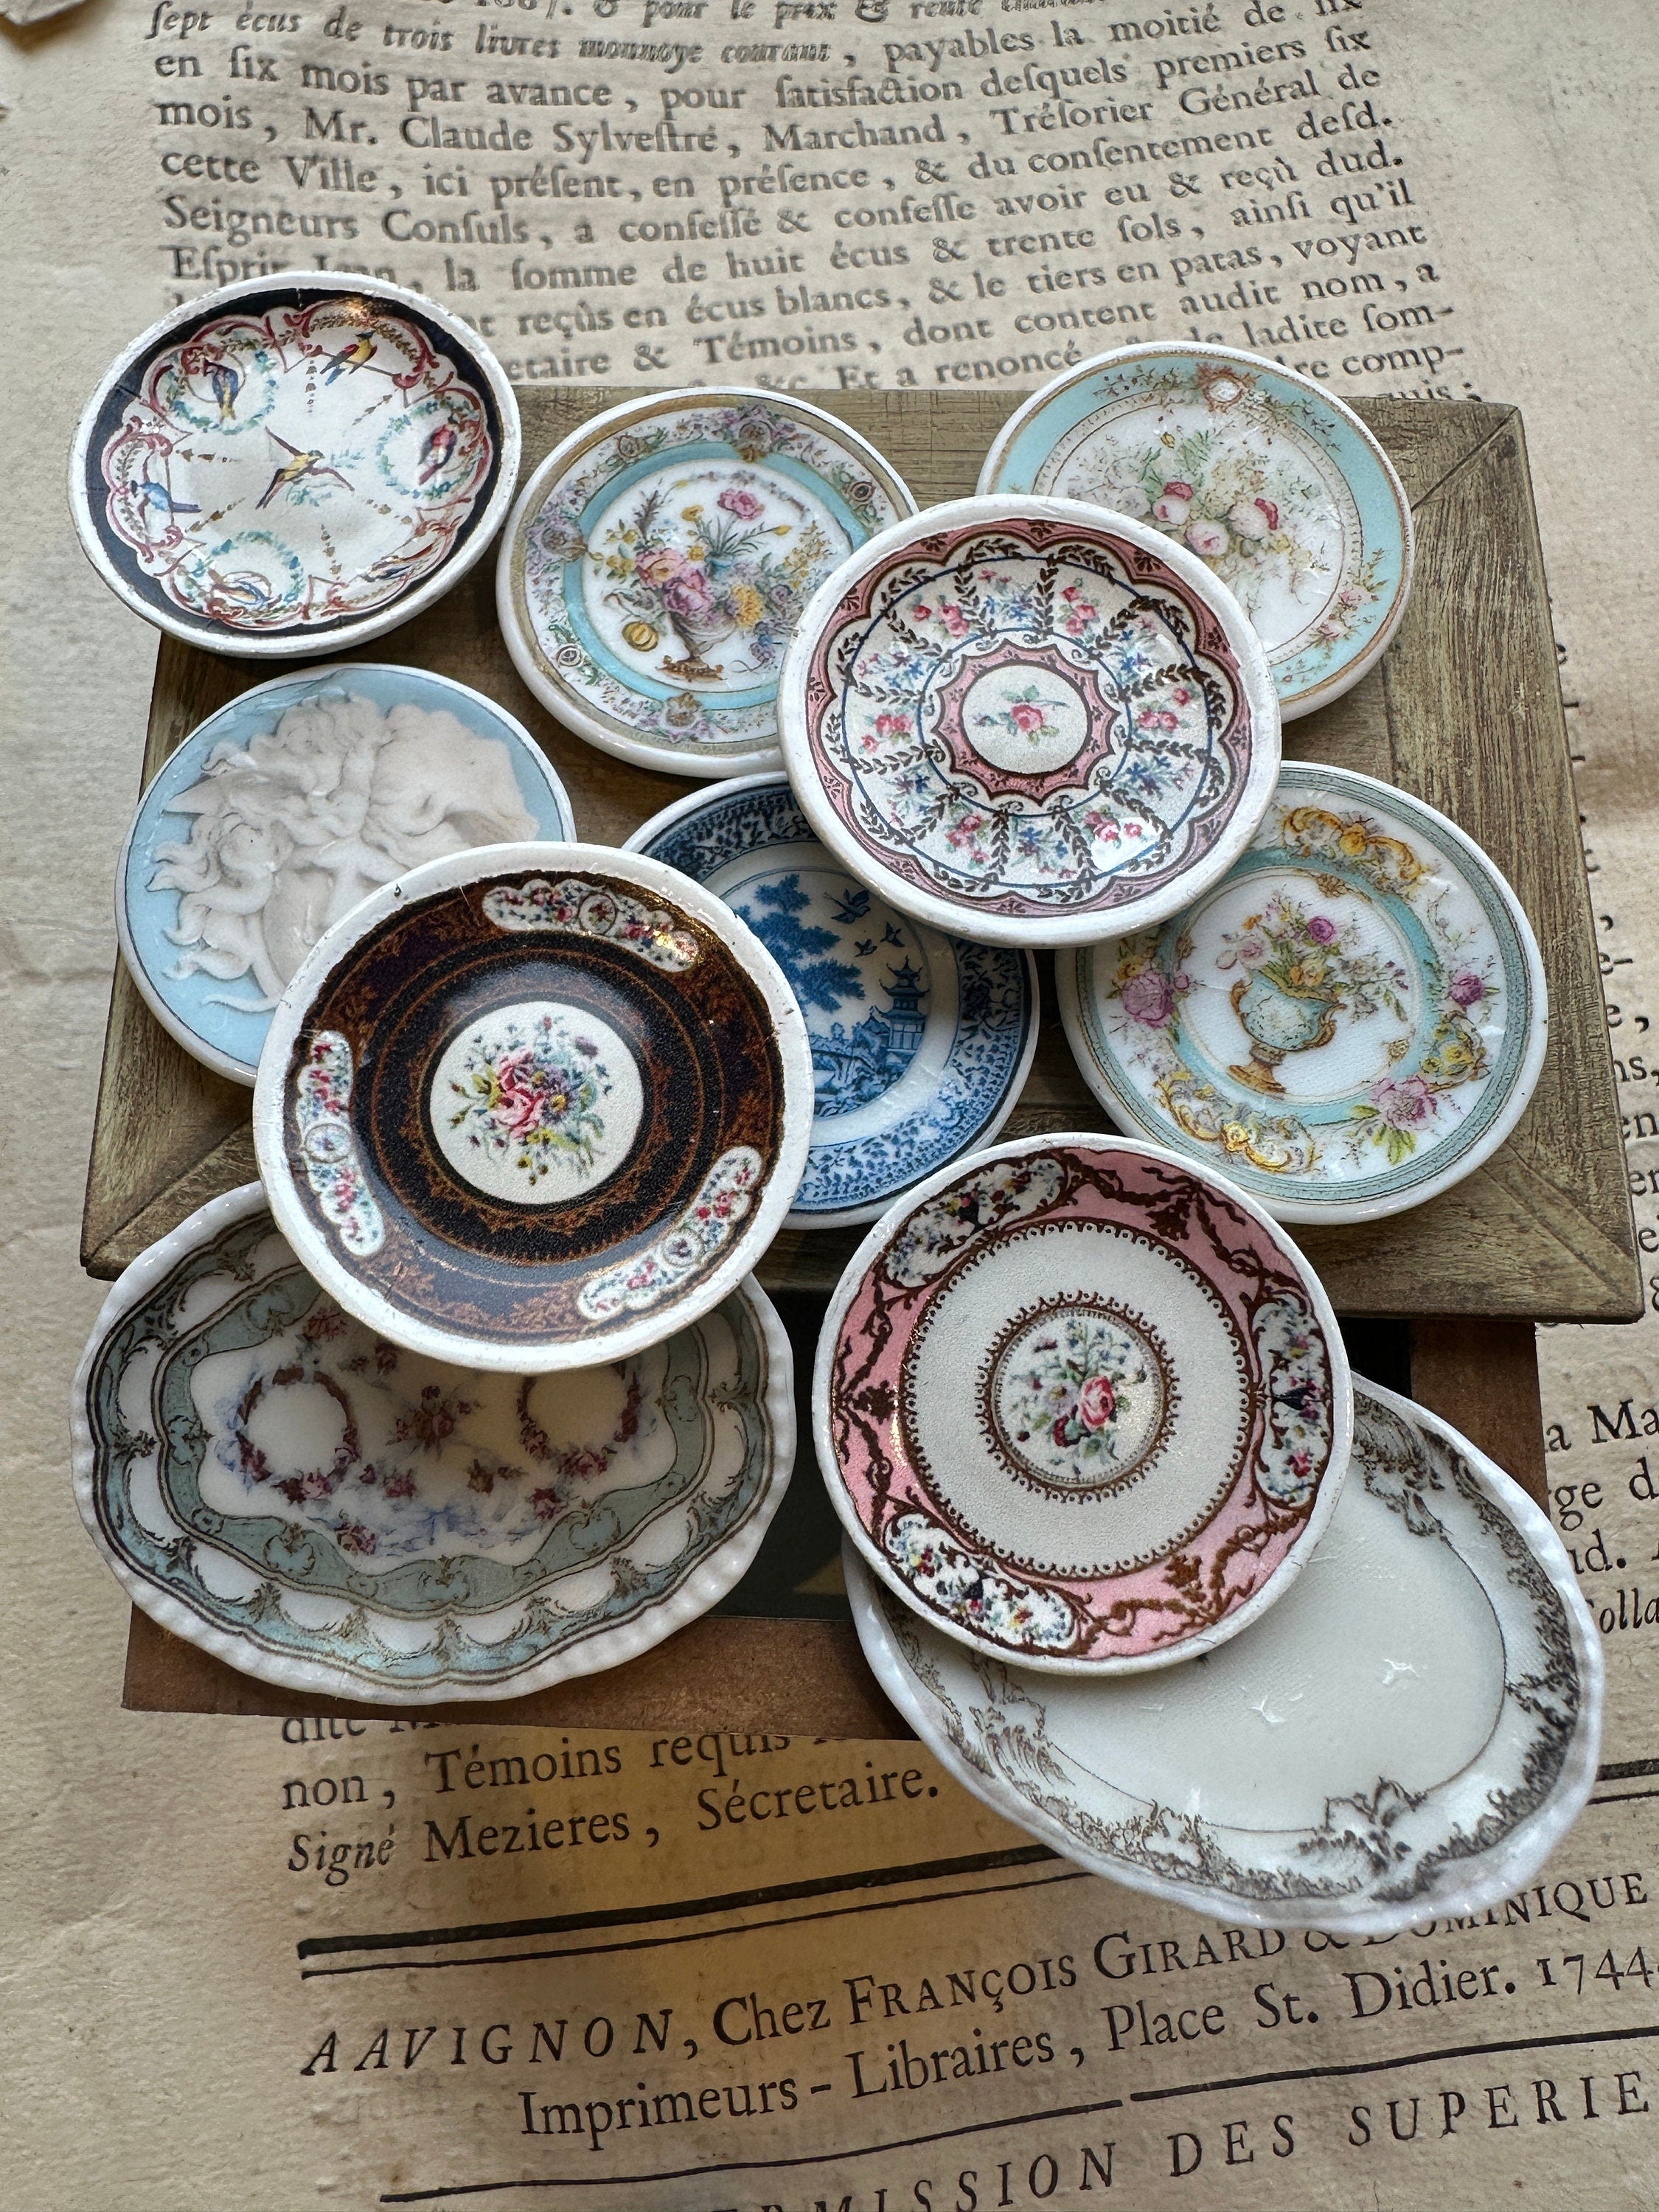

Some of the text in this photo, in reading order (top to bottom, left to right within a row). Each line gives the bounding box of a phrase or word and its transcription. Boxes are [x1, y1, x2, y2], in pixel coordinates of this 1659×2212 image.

[155, 55, 202, 77] en
[300, 60, 389, 95] mois
[405, 76, 467, 112] par
[661, 86, 745, 120] pour
[1155, 37, 1308, 90] premiers
[323, 6, 363, 41] de
[884, 28, 1035, 74] payables
[1051, 21, 1085, 47] la
[1108, 4, 1221, 43] moitié
[1244, 0, 1286, 27] de
[304, 107, 378, 145] Mr.
[399, 115, 533, 151] Claude
[1179, 68, 1319, 116] Général
[1338, 63, 1381, 91] de
[160, 152, 261, 184] cette
[422, 161, 468, 197] ici
[653, 174, 695, 198] en
[914, 158, 949, 184] &
[969, 150, 1015, 180] du
[164, 195, 359, 246] Seigneurs
[776, 206, 813, 234] &
[992, 183, 1088, 217] avoir
[1105, 181, 1150, 206] eu
[1168, 170, 1203, 198] &
[1315, 139, 1404, 178] dud.
[444, 257, 480, 291] la
[663, 254, 708, 284] de
[726, 247, 806, 279] huit
[830, 239, 911, 271] écus
[931, 236, 970, 264] &
[986, 228, 1096, 257] trente
[1329, 178, 1416, 226] qu'il
[622, 304, 668, 330] en
[685, 292, 766, 325] écus
[928, 275, 965, 305] &
[972, 269, 1006, 300] le
[1026, 263, 1108, 294] tiers
[1116, 259, 1161, 284] en
[1290, 224, 1428, 267] voyant
[633, 341, 669, 371] &
[902, 313, 995, 347] dont
[1014, 300, 1158, 333] content
[1179, 279, 1281, 316] audit
[1415, 262, 1441, 284] a
[896, 367, 919, 387] a
[1242, 314, 1349, 348] ladite
[1341, 344, 1465, 374] comp-
[1585, 1587, 1659, 1634] olla
[424, 1736, 622, 1795] Témoins
[287, 1823, 400, 1886] Signé
[698, 1761, 940, 1832] Sécretaire.
[713, 1990, 832, 2047] Chez
[1093, 1927, 1286, 1980] GIRARD
[518, 2074, 799, 2151] Imprimeurs
[1101, 1997, 1225, 2053] Place
[1253, 1983, 1318, 2029] St.
[1342, 1959, 1516, 2019] Didier.
[1167, 2114, 1295, 2178] DES
